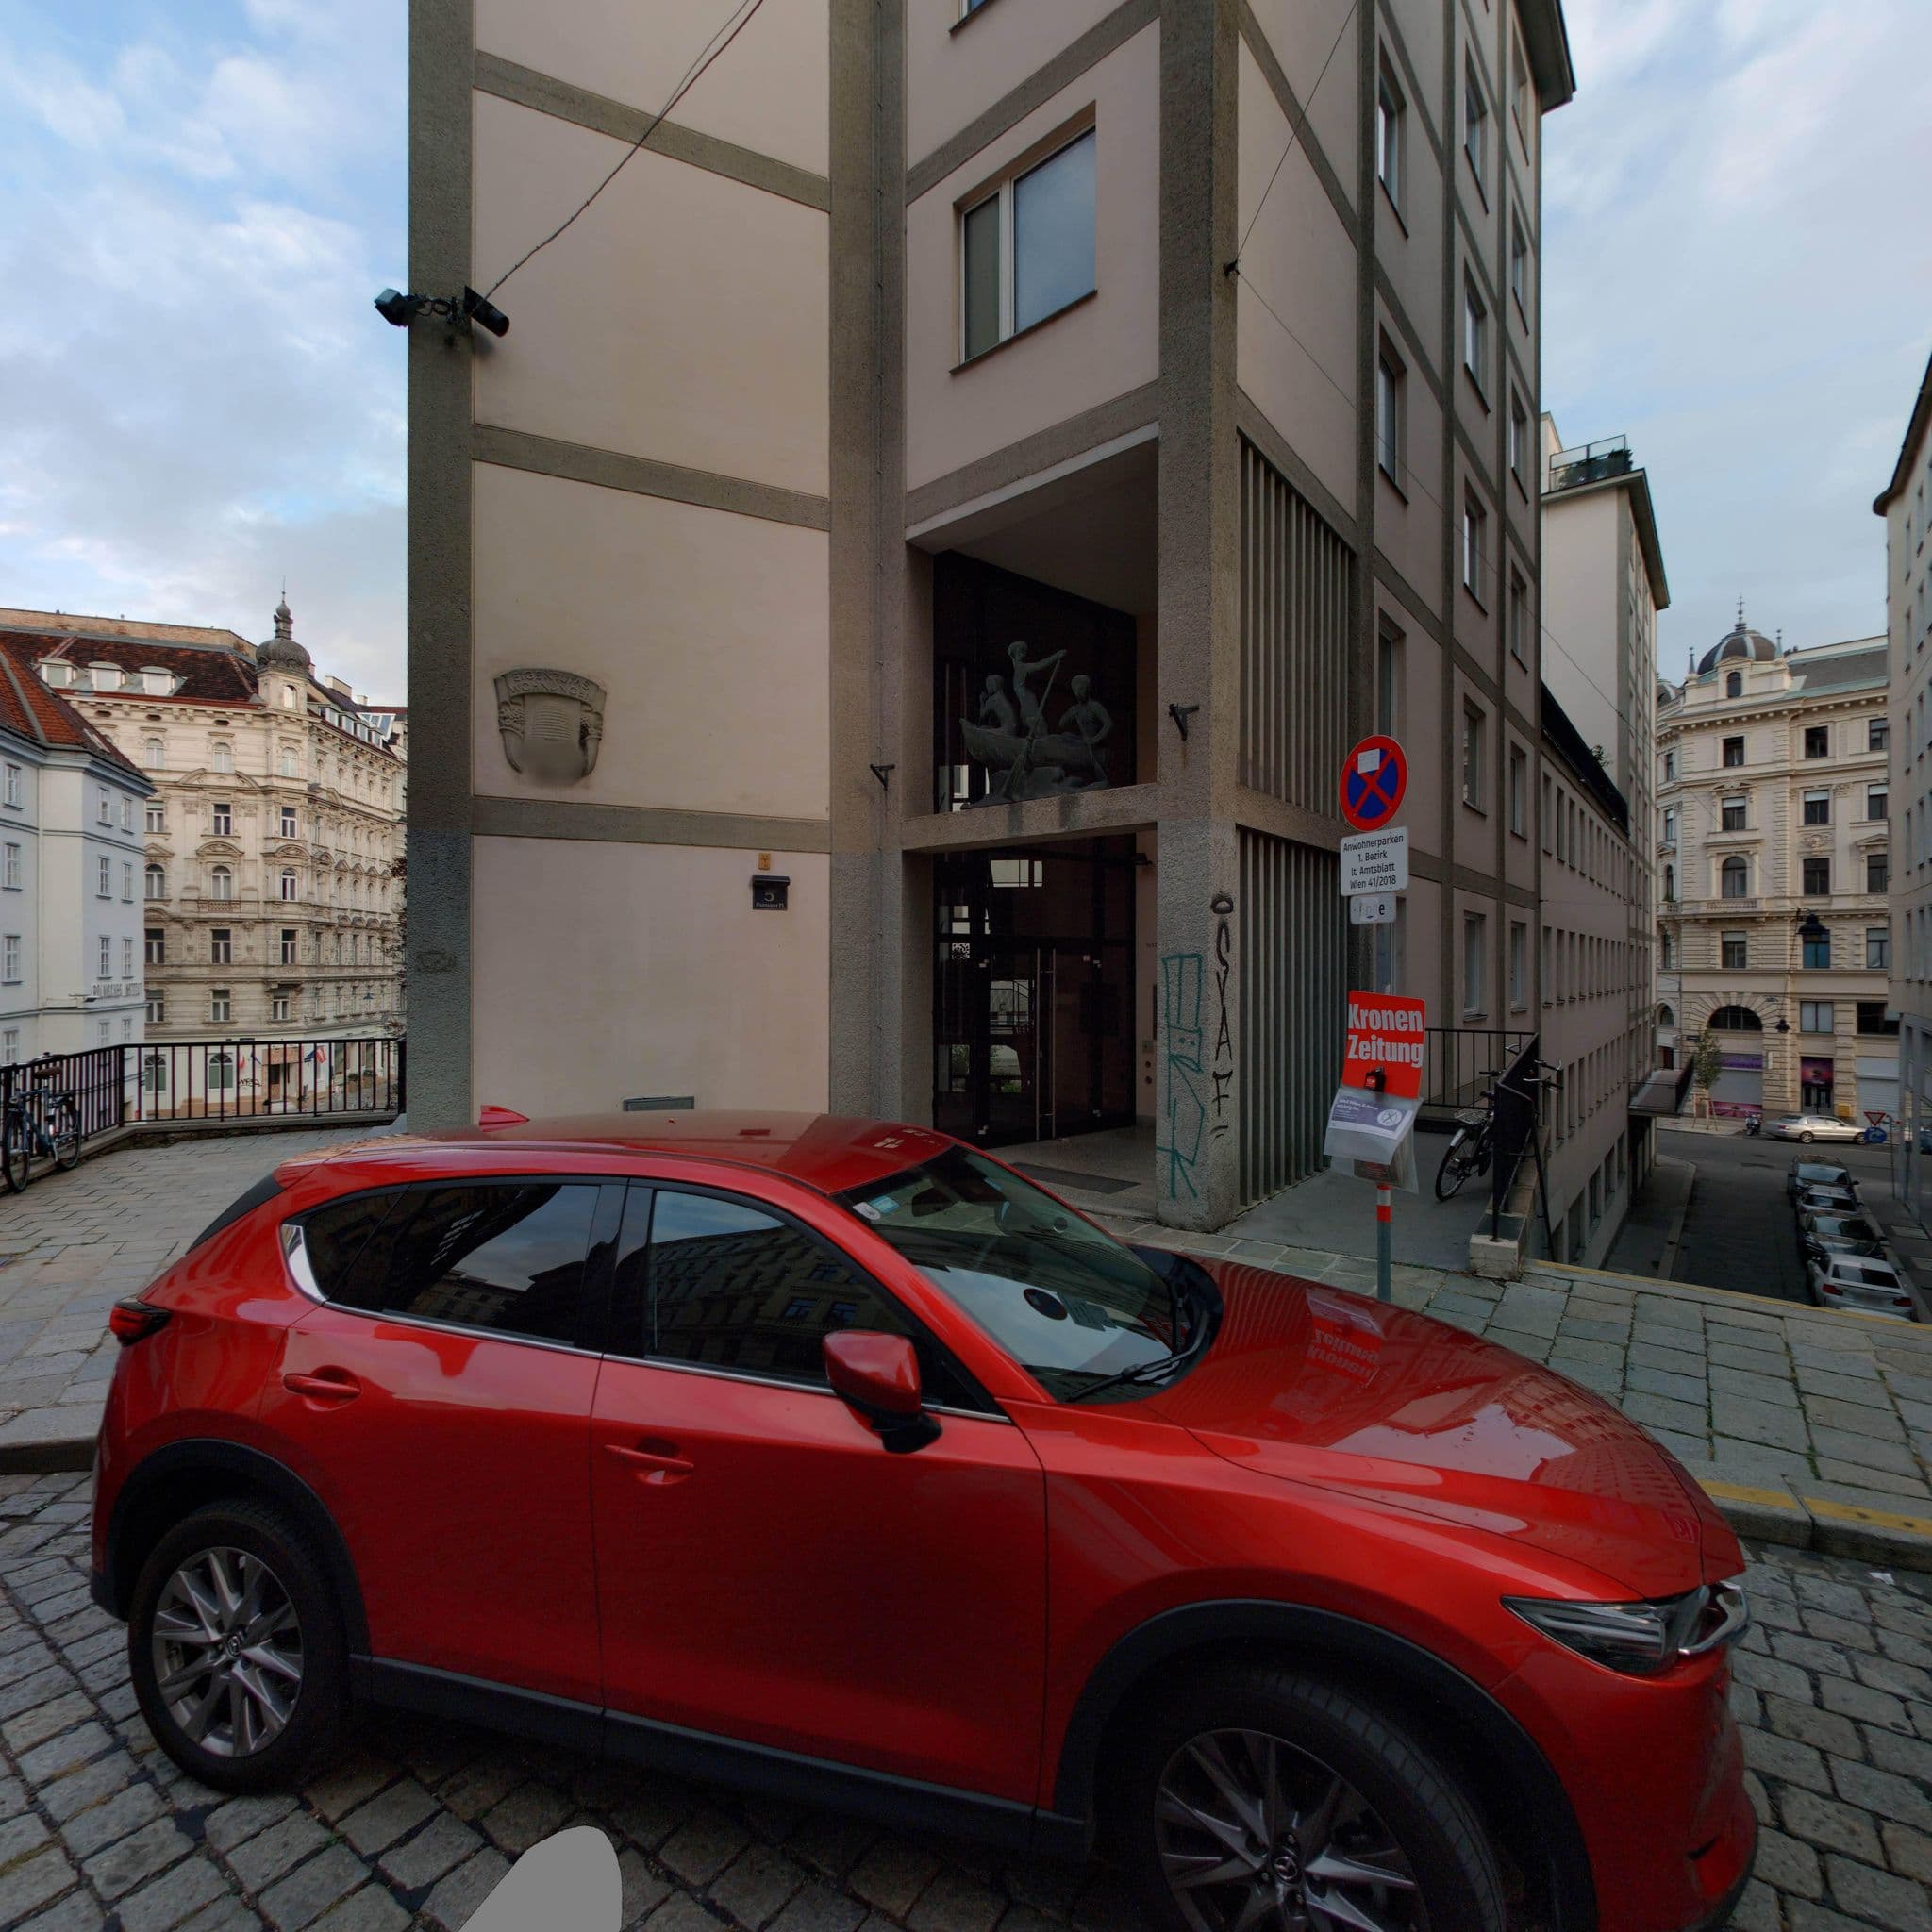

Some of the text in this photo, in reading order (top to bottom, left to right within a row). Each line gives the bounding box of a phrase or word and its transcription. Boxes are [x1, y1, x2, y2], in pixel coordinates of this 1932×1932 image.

[1343, 835, 1404, 852] Anwohnerparken
[1365, 850, 1388, 861] Bezirk
[1359, 862, 1395, 875] Amtsblatt
[1350, 874, 1396, 889] Wien 41/2018
[1348, 1003, 1424, 1032] Kronen
[1347, 1034, 1424, 1068] Zeitung
